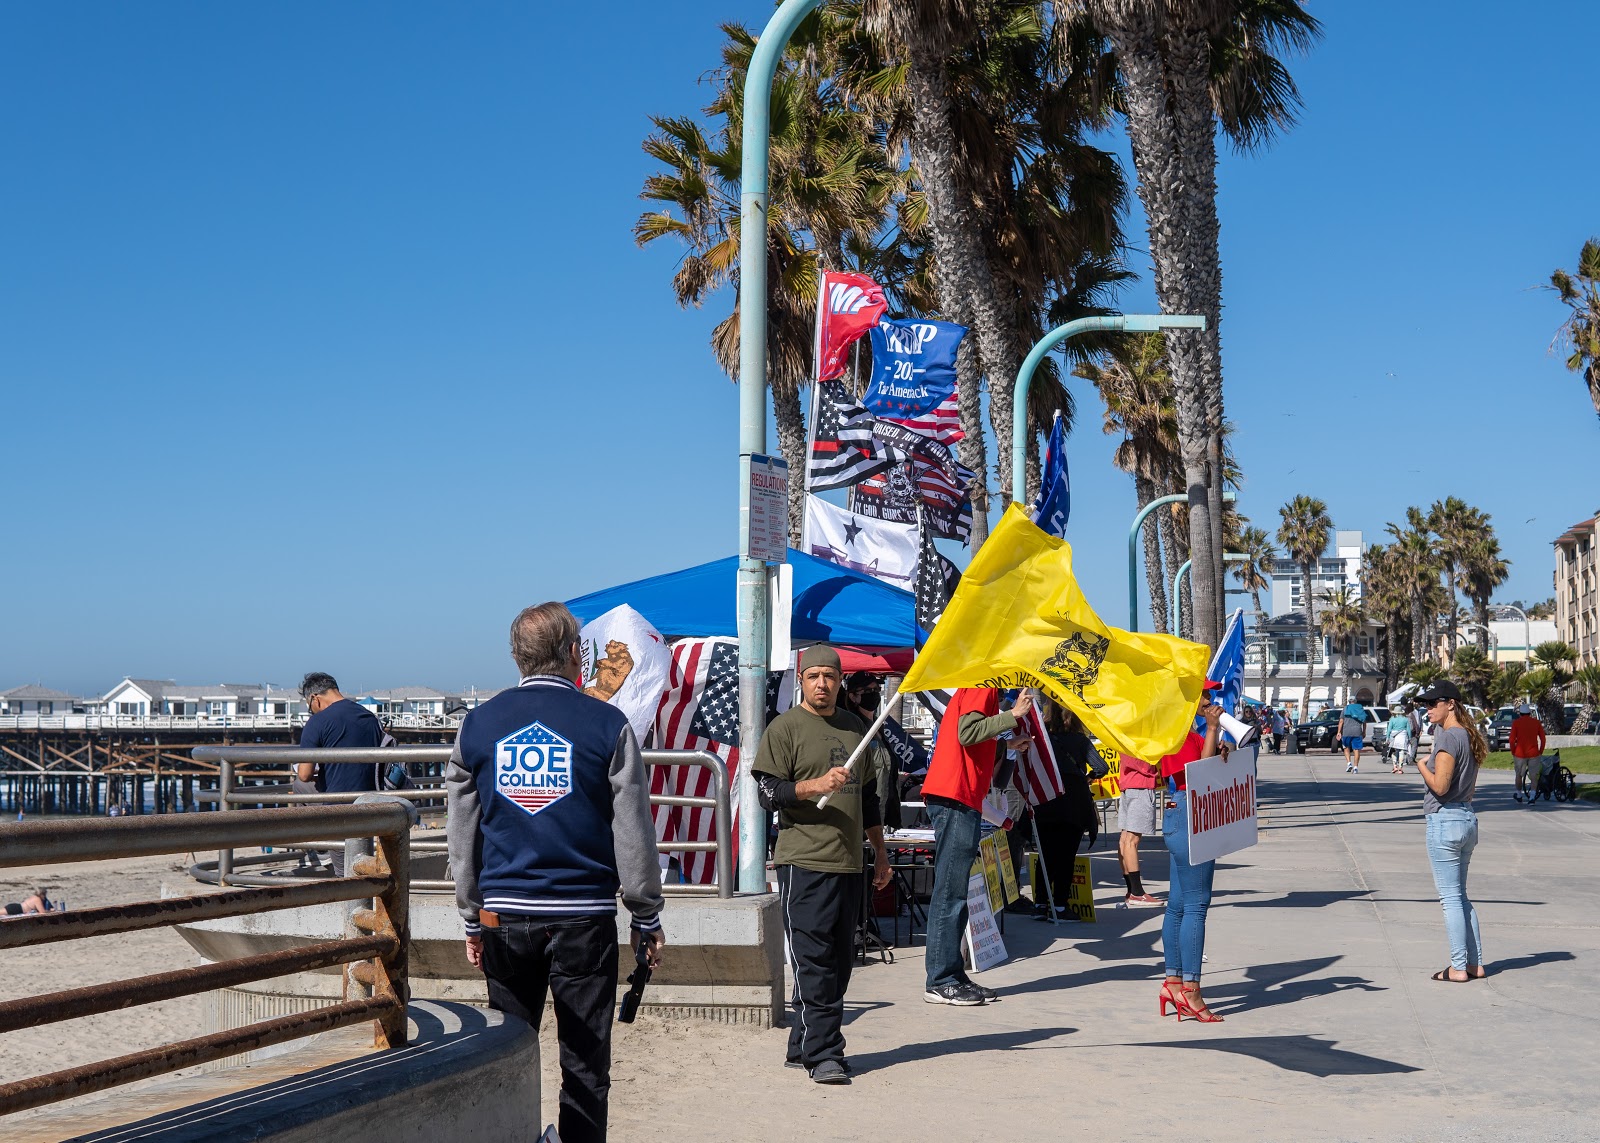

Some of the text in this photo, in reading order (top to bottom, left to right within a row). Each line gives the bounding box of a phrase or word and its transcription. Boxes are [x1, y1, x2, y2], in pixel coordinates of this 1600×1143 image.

[752, 473, 787, 491] REGULATIONS
[501, 746, 567, 773] JOE
[499, 773, 569, 788] COLLINS
[1191, 774, 1255, 835] Brainwashed!
